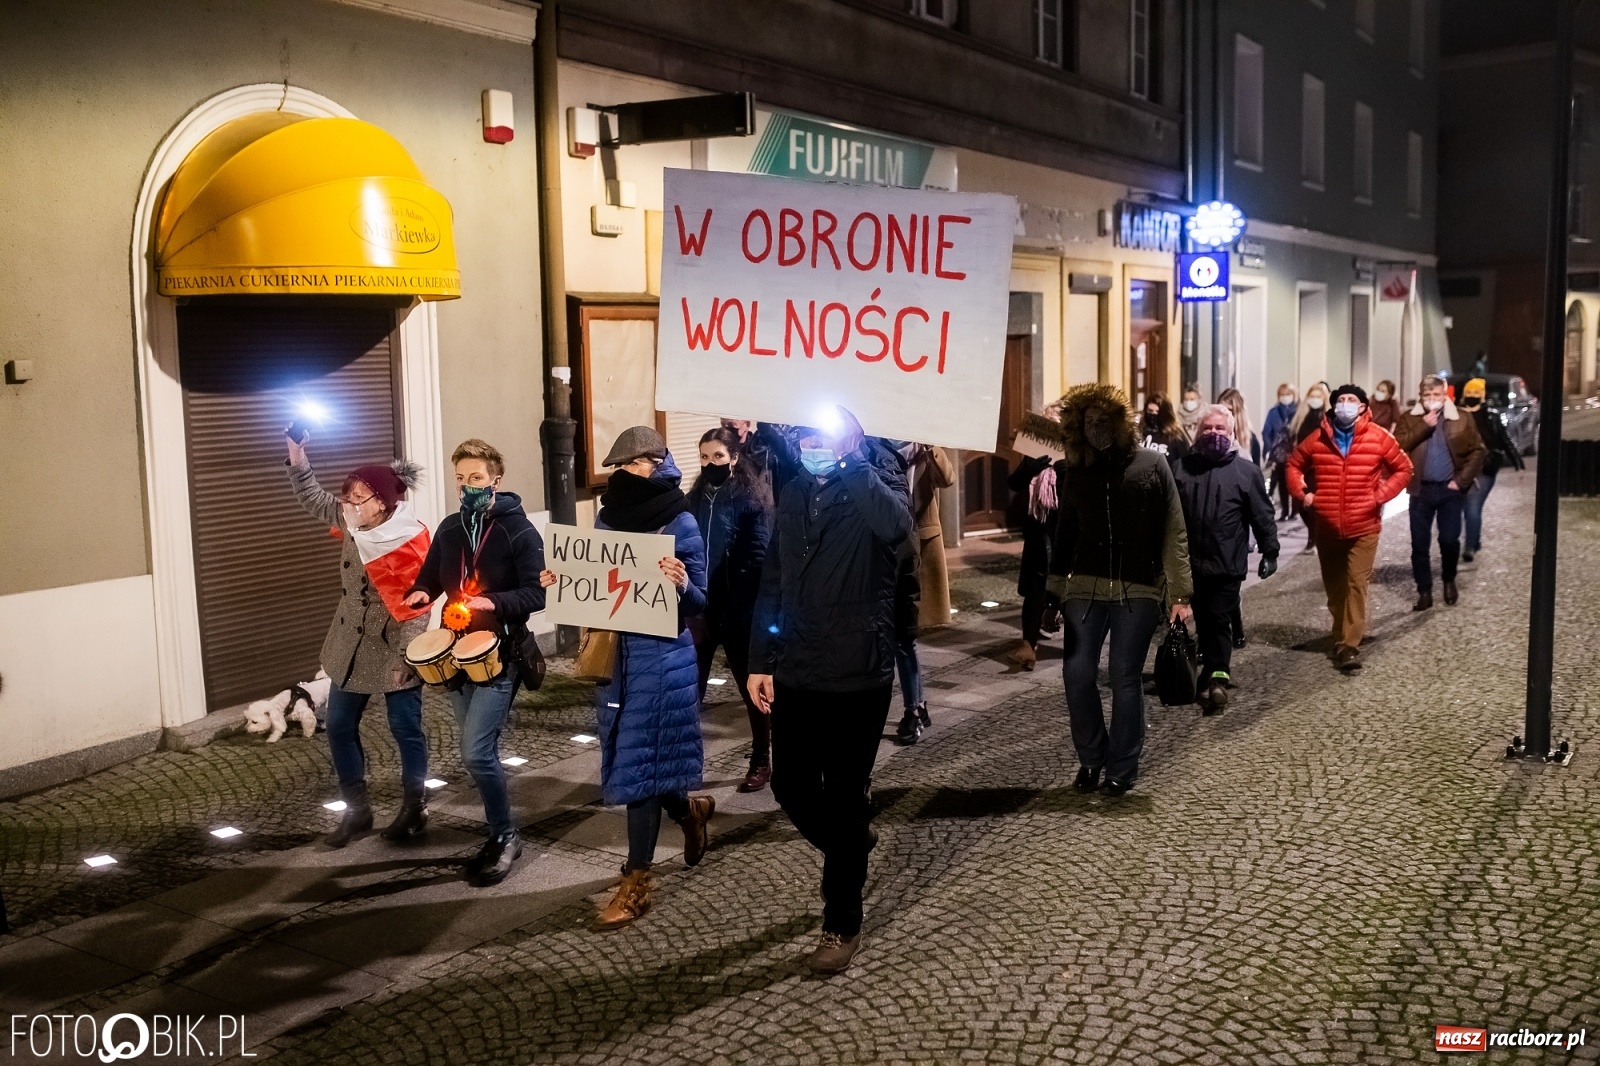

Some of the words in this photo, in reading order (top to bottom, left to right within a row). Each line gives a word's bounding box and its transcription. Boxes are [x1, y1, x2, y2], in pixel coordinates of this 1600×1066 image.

[788, 128, 904, 186] FUJIFILM
[363, 221, 436, 244] Markiewka
[674, 204, 713, 257] W
[741, 208, 972, 281] OBRONIE
[1119, 202, 1182, 252] KANTOR
[164, 275, 236, 289] PIEKARNIA
[239, 274, 329, 287] CUKIERNIA
[334, 274, 408, 288] PIEKARNIA
[410, 276, 455, 289] CUKIERNIA
[681, 287, 950, 374] WOLNOŚCI
[553, 533, 638, 568] WOLNA
